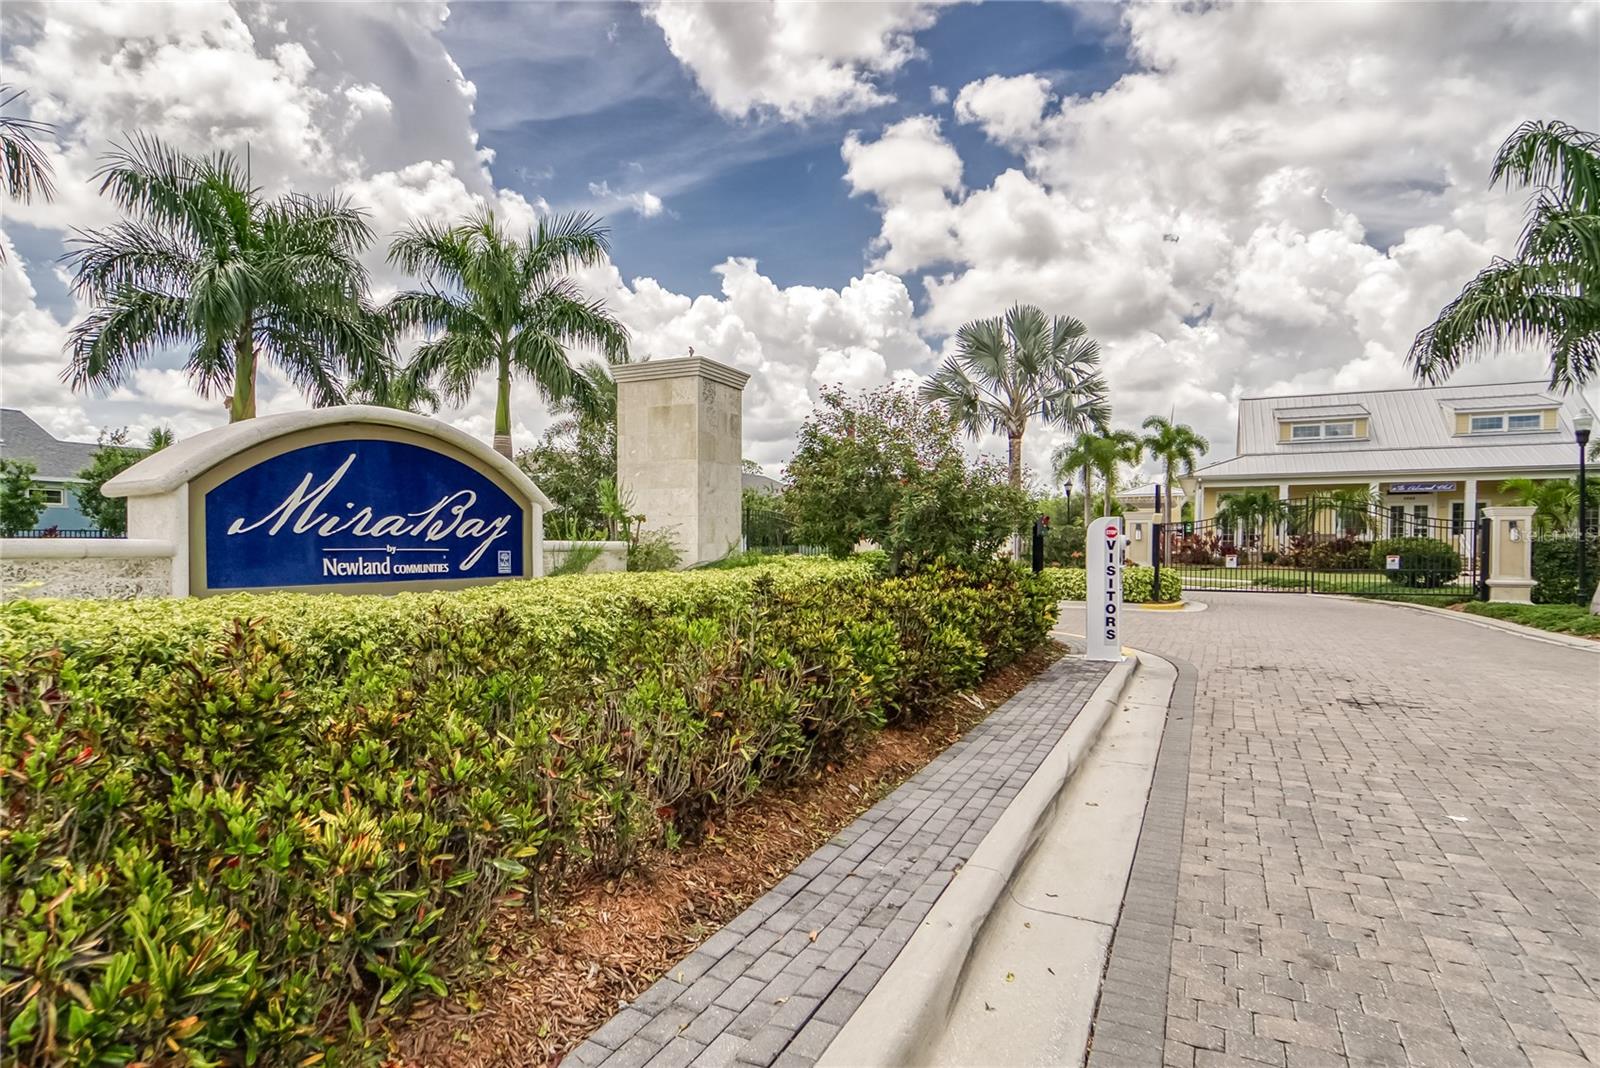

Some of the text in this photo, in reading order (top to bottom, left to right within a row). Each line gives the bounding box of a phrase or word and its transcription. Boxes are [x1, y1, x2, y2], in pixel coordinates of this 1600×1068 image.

[386, 544, 397, 554] by
[322, 556, 449, 576] Newland COMMUNITIES
[1106, 540, 1116, 640] VISITORS
